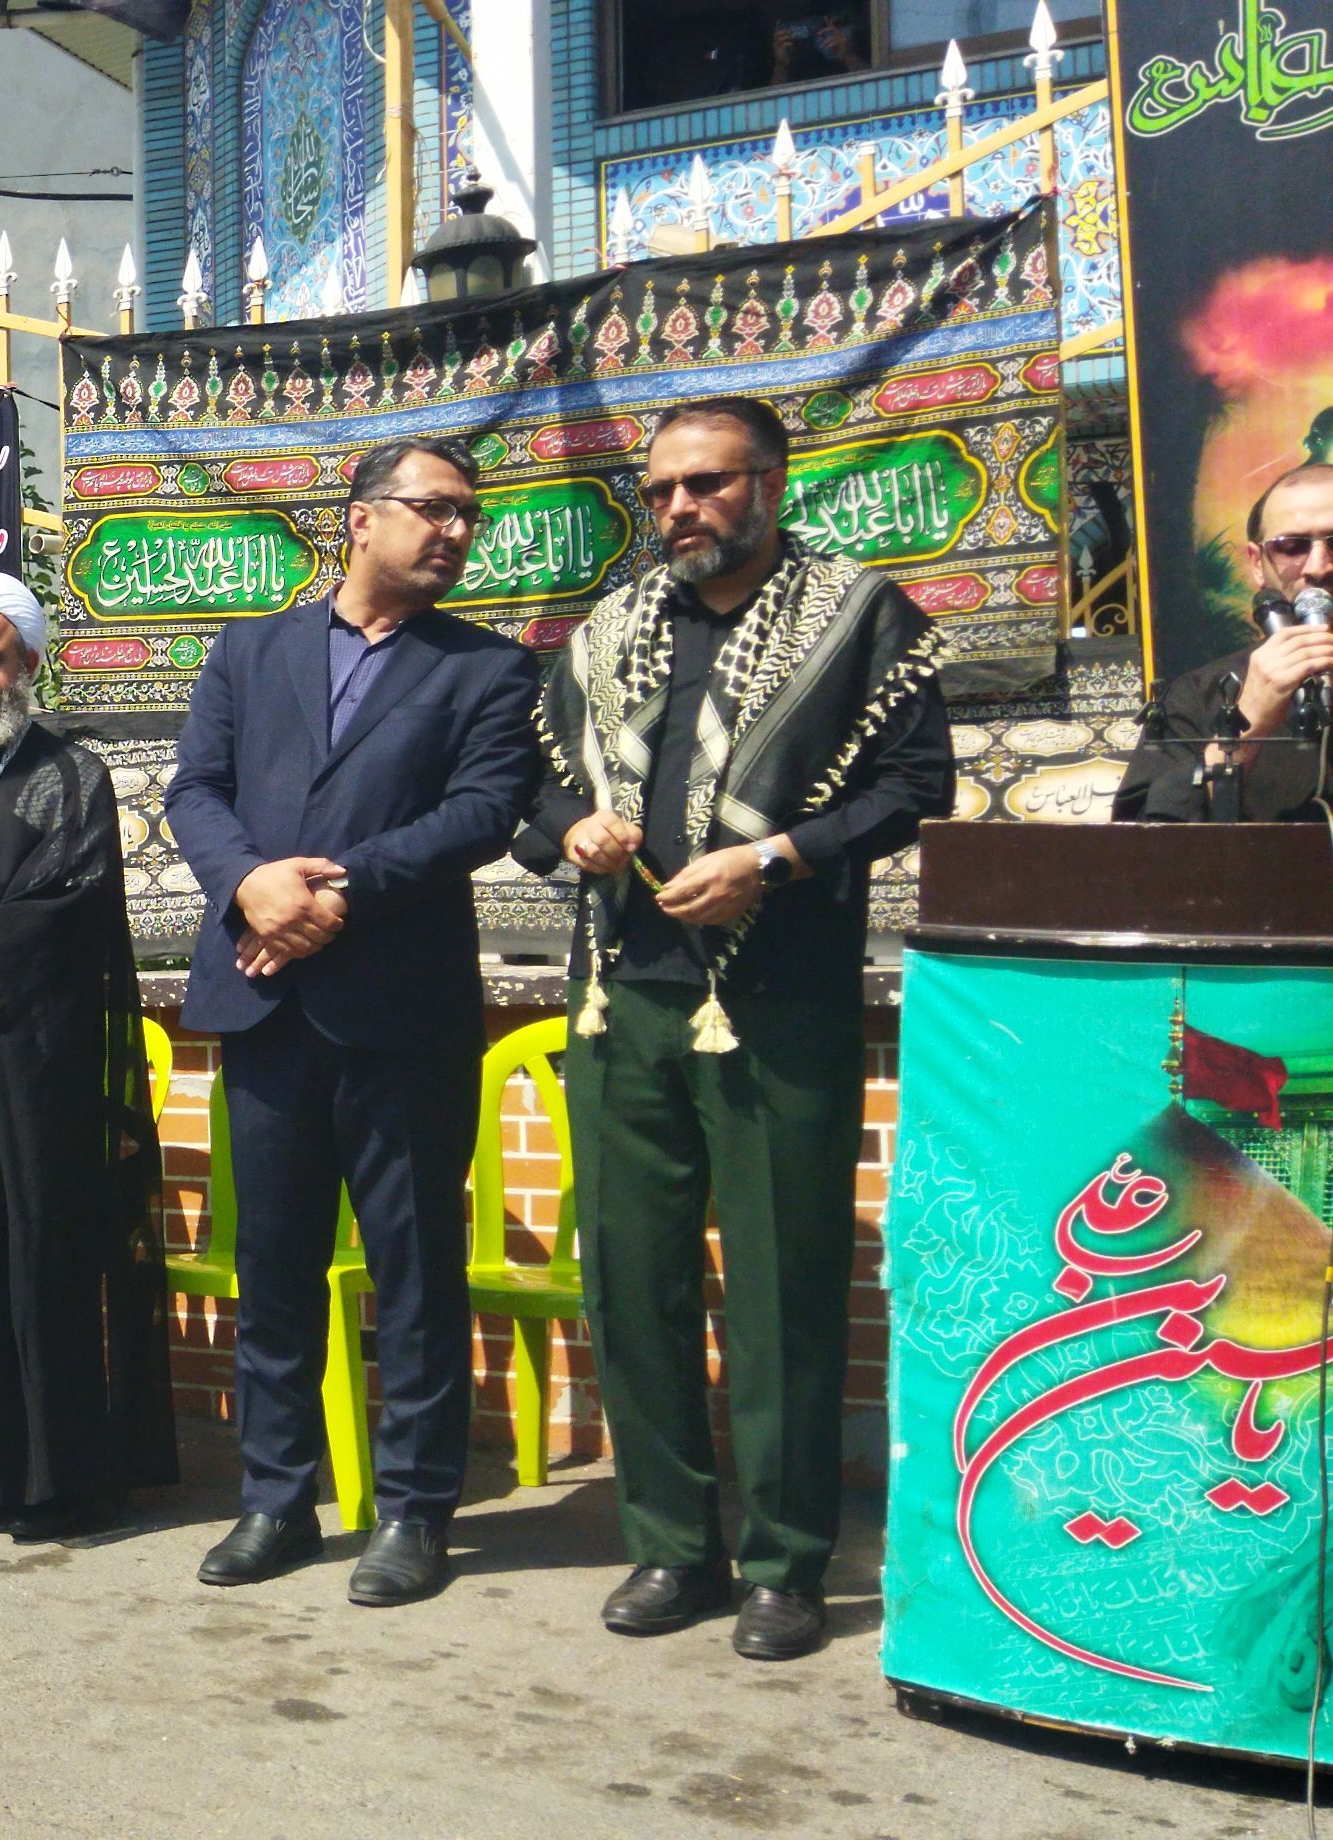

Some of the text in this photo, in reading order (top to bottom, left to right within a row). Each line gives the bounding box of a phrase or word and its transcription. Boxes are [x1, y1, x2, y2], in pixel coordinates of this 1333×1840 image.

[575, 505, 595, 579] یا
[925, 461, 949, 541] یا
[268, 534, 285, 603] یا
[1054, 1168, 1202, 1276] علی
[1204, 1378, 1290, 1517] یا
[956, 1336, 1333, 1693] سین
